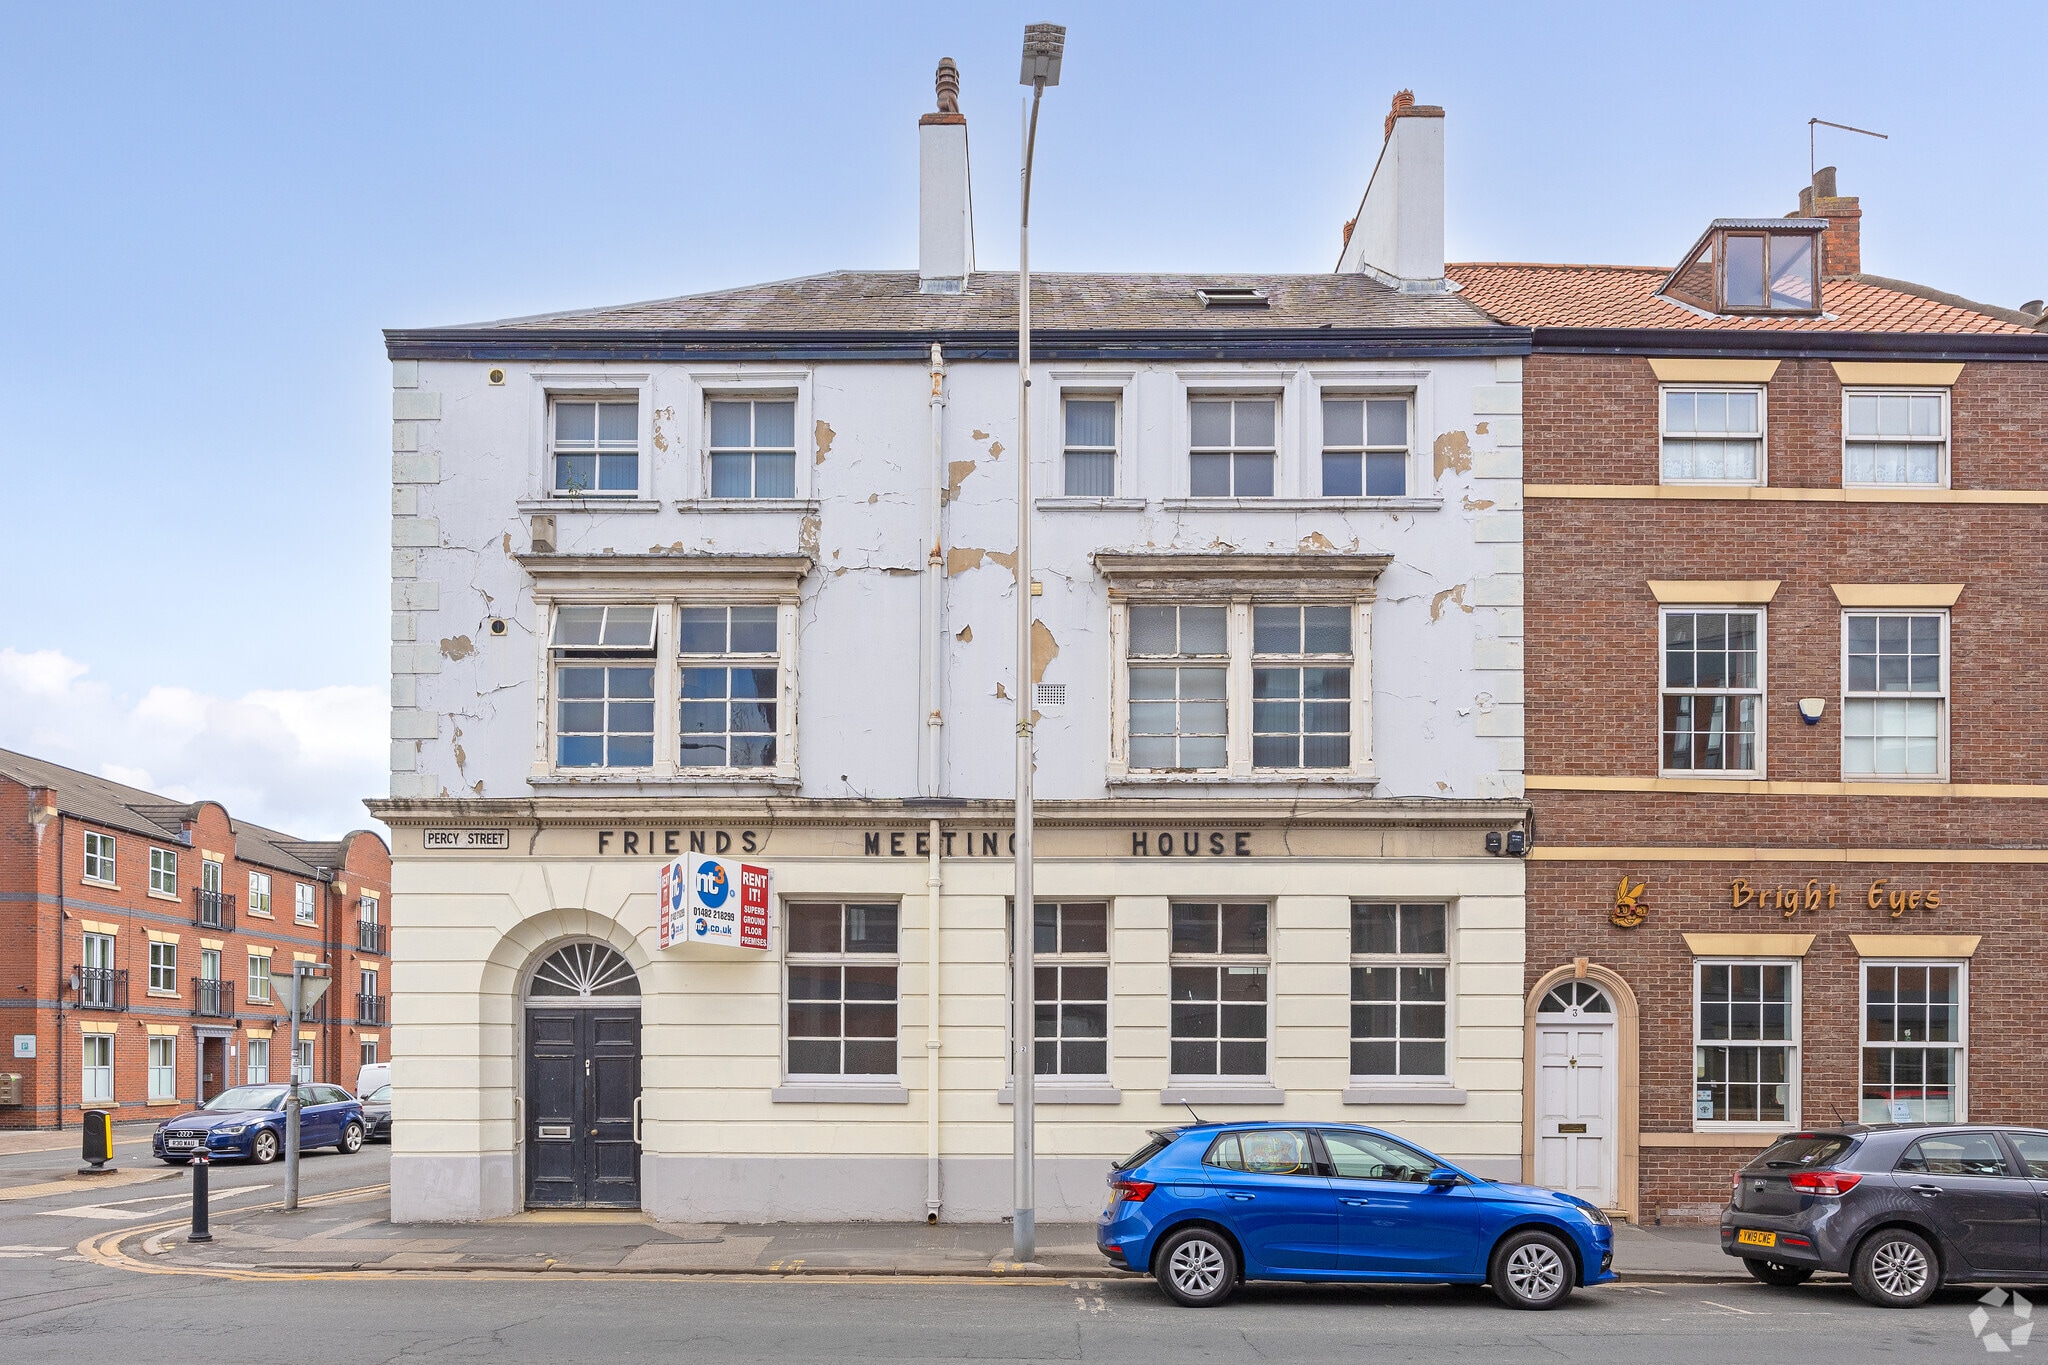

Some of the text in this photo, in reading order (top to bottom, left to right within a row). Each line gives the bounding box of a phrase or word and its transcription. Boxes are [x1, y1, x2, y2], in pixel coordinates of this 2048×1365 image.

[428, 832, 505, 844] PERCY STREET
[598, 830, 757, 854] FRIENDS
[1132, 831, 1251, 856] HOUSE
[742, 871, 768, 888] RENT
[748, 887, 761, 902] IT!
[1730, 877, 1942, 918] Bright Eyes
[693, 906, 712, 918] 01482
[743, 904, 765, 916] SUPERB
[743, 915, 766, 926] GROUND
[744, 926, 762, 936] FLOOR
[741, 935, 767, 947] PREMISES
[1572, 1008, 1578, 1017] 3
